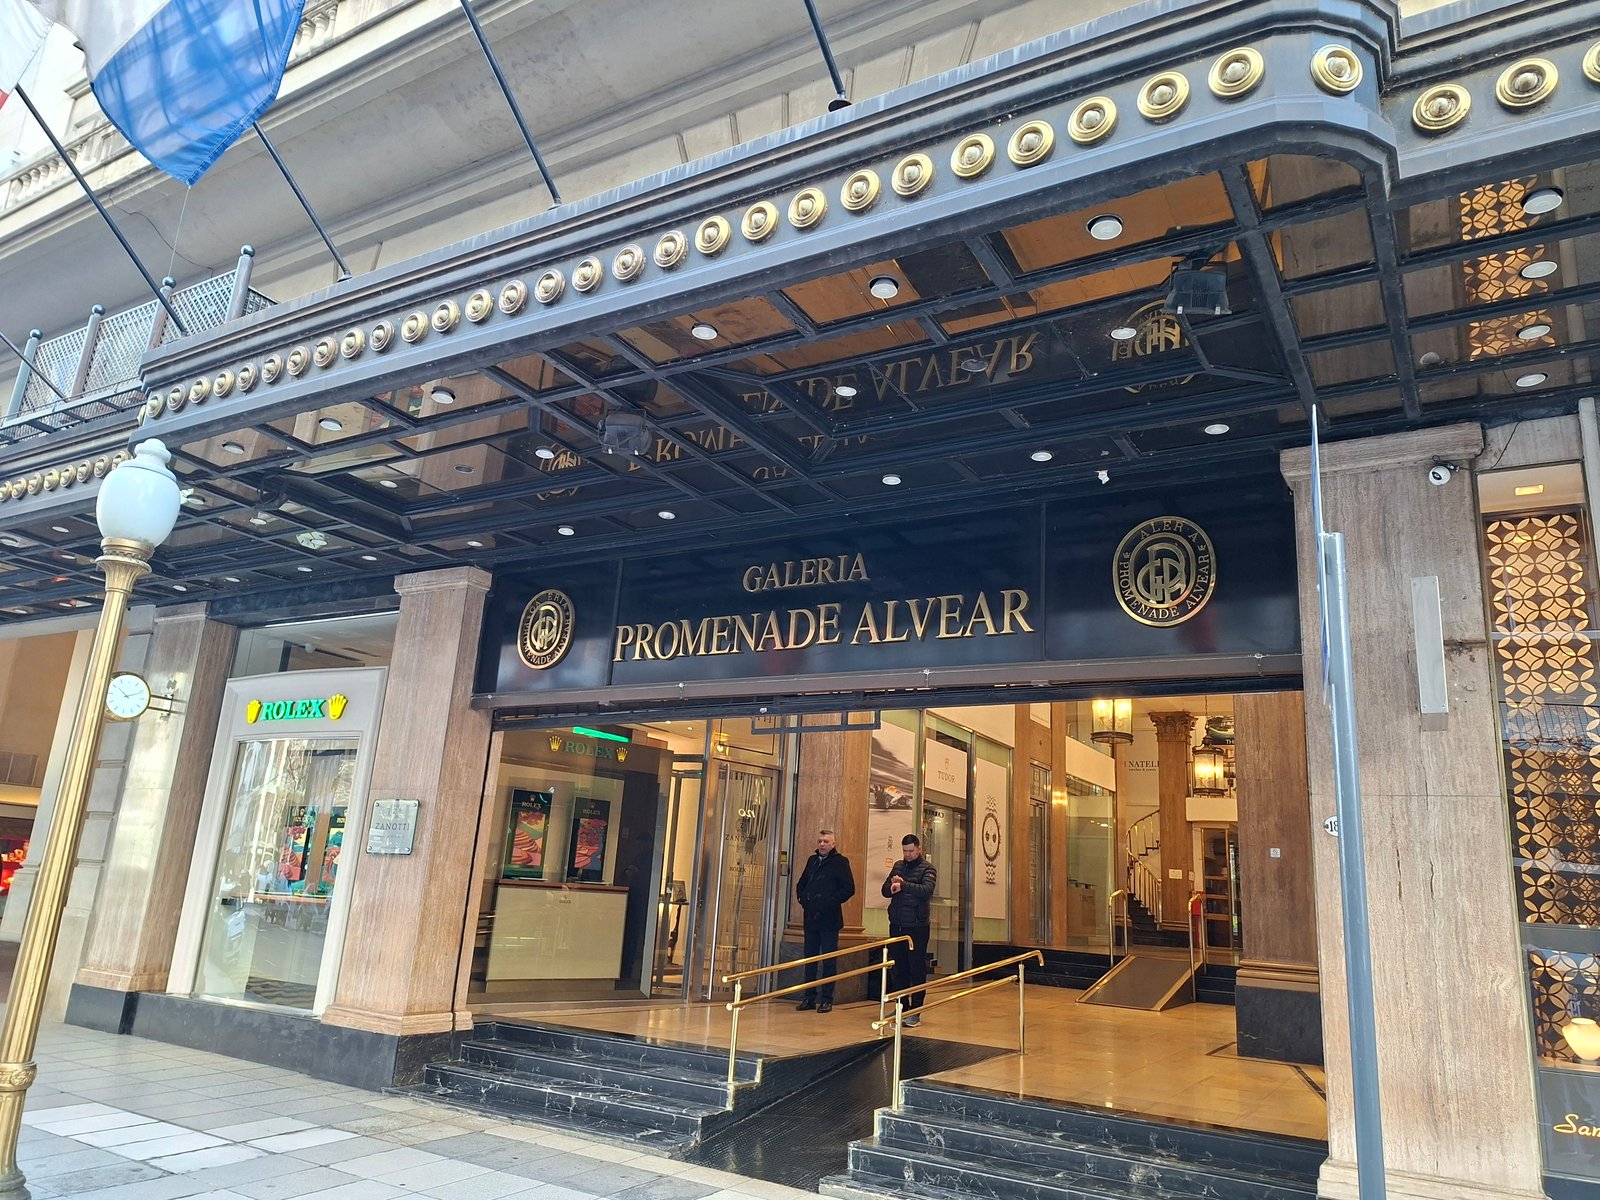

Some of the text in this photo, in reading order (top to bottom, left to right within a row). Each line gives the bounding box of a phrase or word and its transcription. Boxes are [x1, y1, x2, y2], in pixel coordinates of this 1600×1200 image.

[742, 552, 870, 593] GALERIA
[1119, 561, 1180, 619] PROMENADE
[1186, 554, 1209, 610] ALVEAR
[612, 603, 843, 662] PROMENADE
[850, 589, 1036, 645] ALVEAR
[260, 699, 326, 720] ROLEX
[564, 741, 613, 759] ROLEX
[937, 770, 956, 783] TUDOR
[375, 822, 410, 831] ZANOTTI
